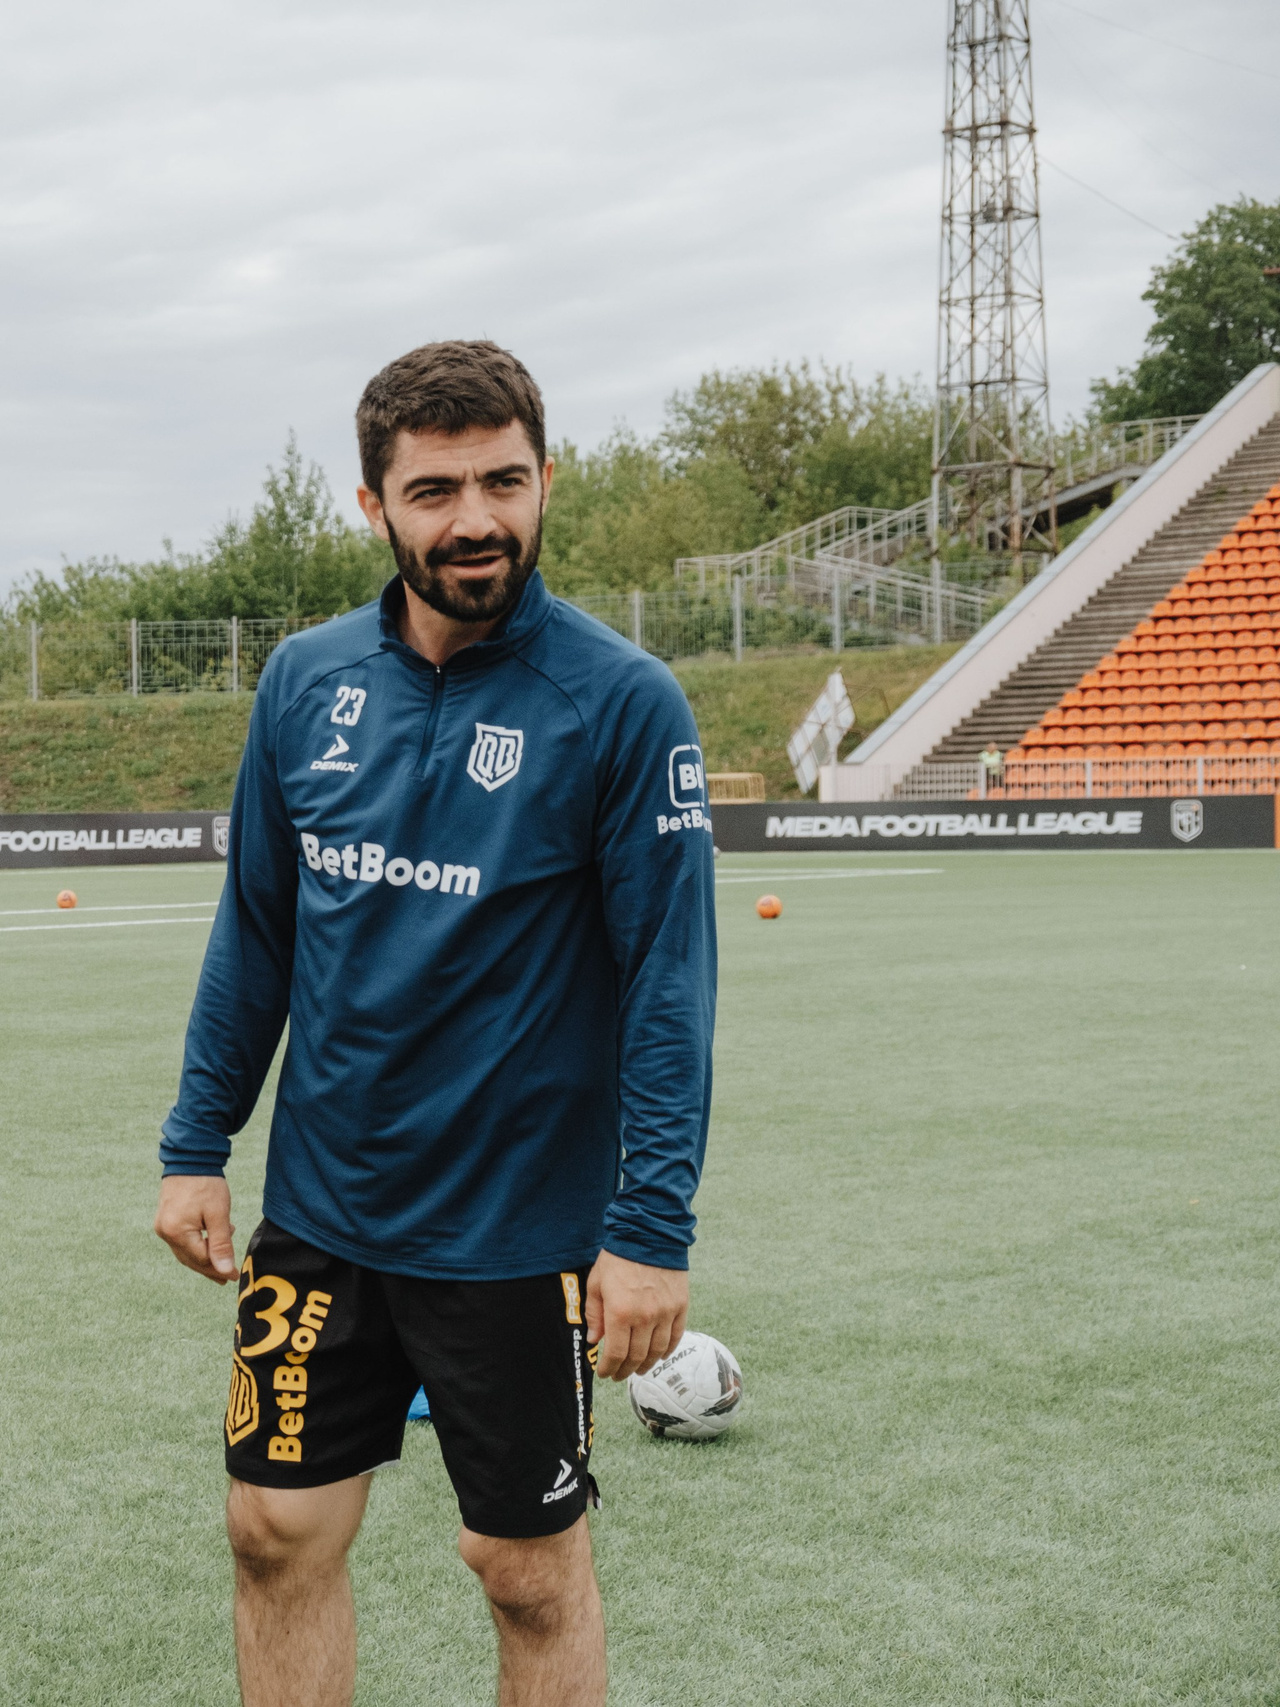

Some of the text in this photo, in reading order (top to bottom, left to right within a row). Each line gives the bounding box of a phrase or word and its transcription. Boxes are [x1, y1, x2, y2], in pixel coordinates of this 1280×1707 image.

[330, 685, 367, 727] 23
[309, 760, 360, 773] DEMIX
[116, 827, 202, 849] LEAGUE
[764, 810, 1144, 838] MEDIA FOOTBALL LEAGUE
[300, 832, 481, 897] BetBoom
[564, 1276, 579, 1320] PRO
[652, 1345, 697, 1379] DEMIX
[542, 1477, 579, 1504] DEMIX
